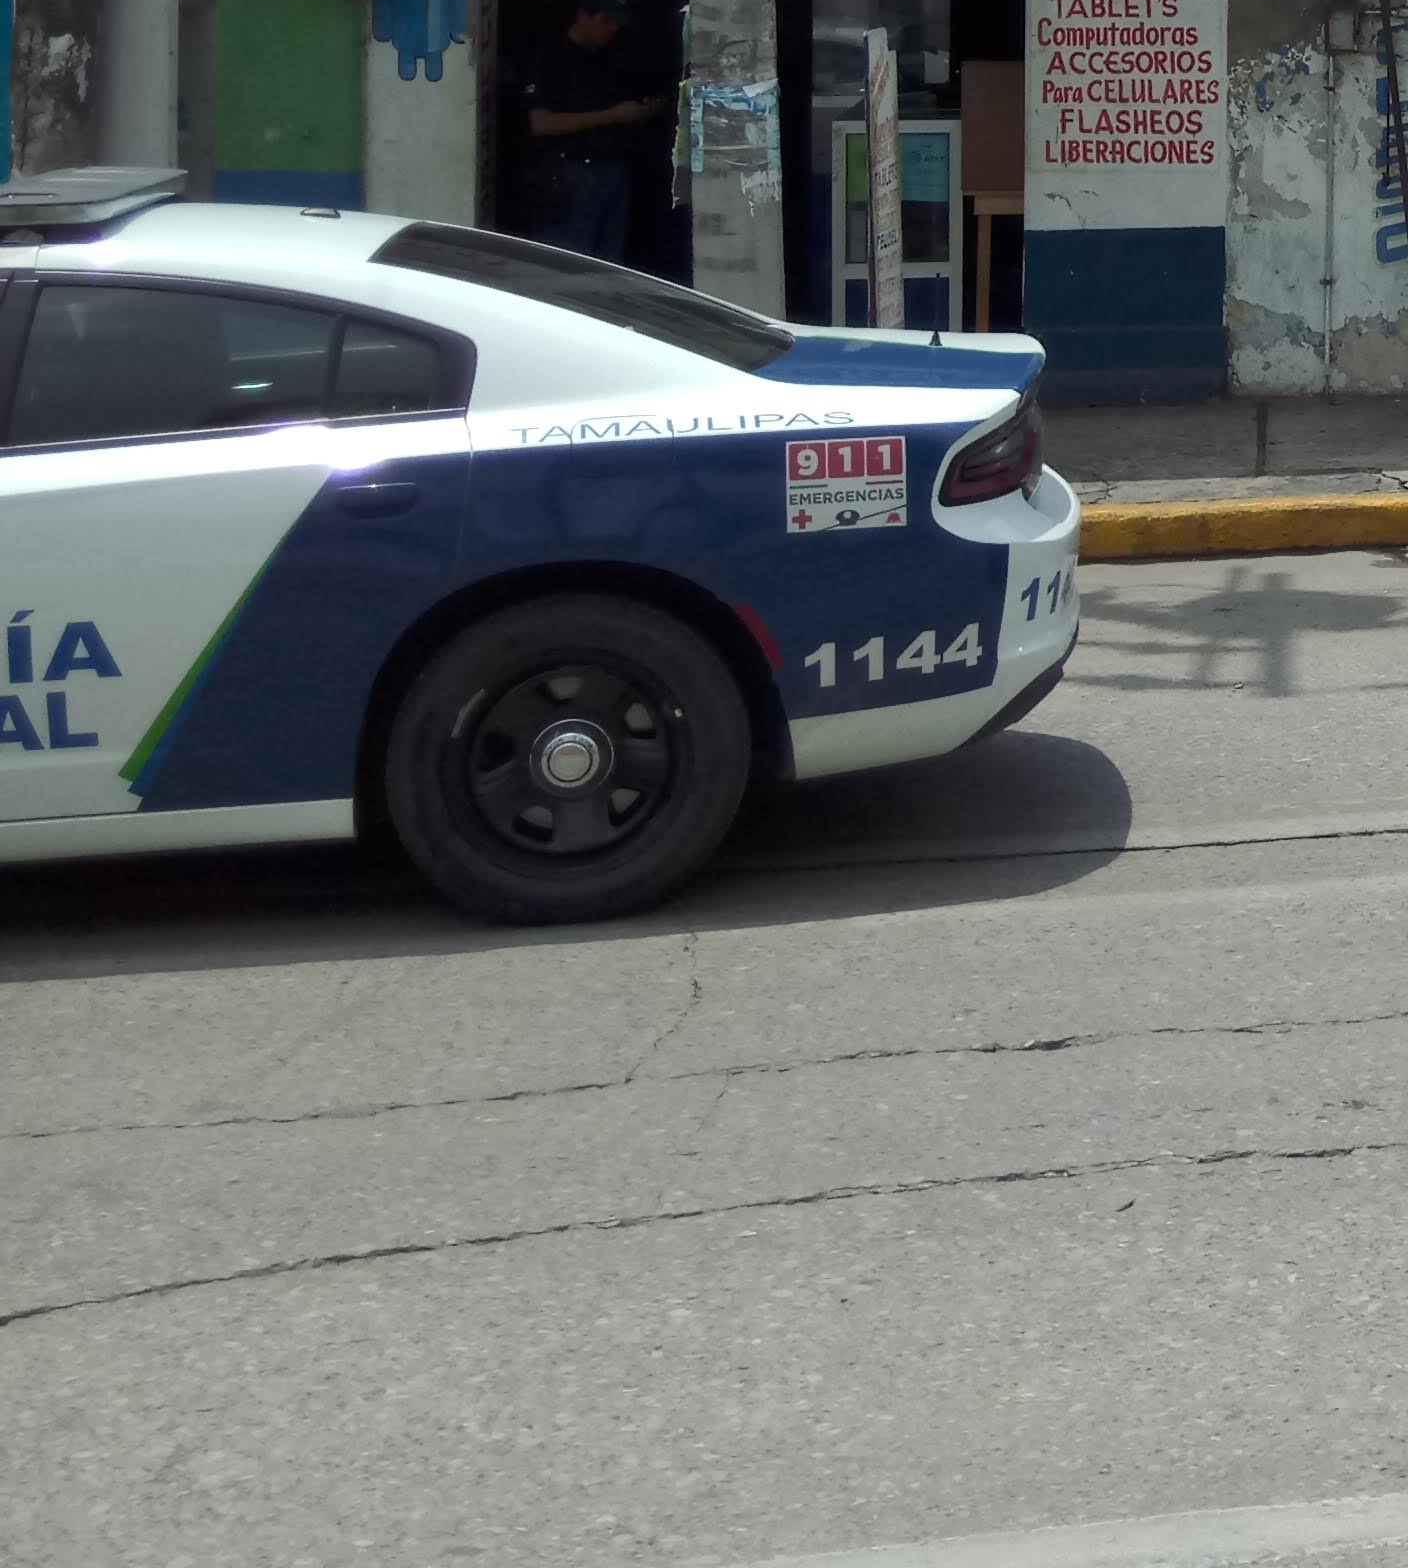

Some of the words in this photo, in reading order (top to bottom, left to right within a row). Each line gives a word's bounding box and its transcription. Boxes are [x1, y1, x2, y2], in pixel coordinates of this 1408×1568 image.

[1037, 17, 1199, 49] Computadoras
[1045, 50, 1212, 75] ACCESORIOS
[1042, 79, 1084, 104] Para
[1086, 79, 1219, 105] CELULARES
[1060, 108, 1203, 136] FLASHEOS
[1045, 139, 1216, 165] LIBERACIONES
[510, 410, 856, 445] TAMAULIPAS
[796, 443, 892, 477] 911
[788, 487, 904, 507] EMERGENCIAS
[804, 622, 982, 687] 1144
